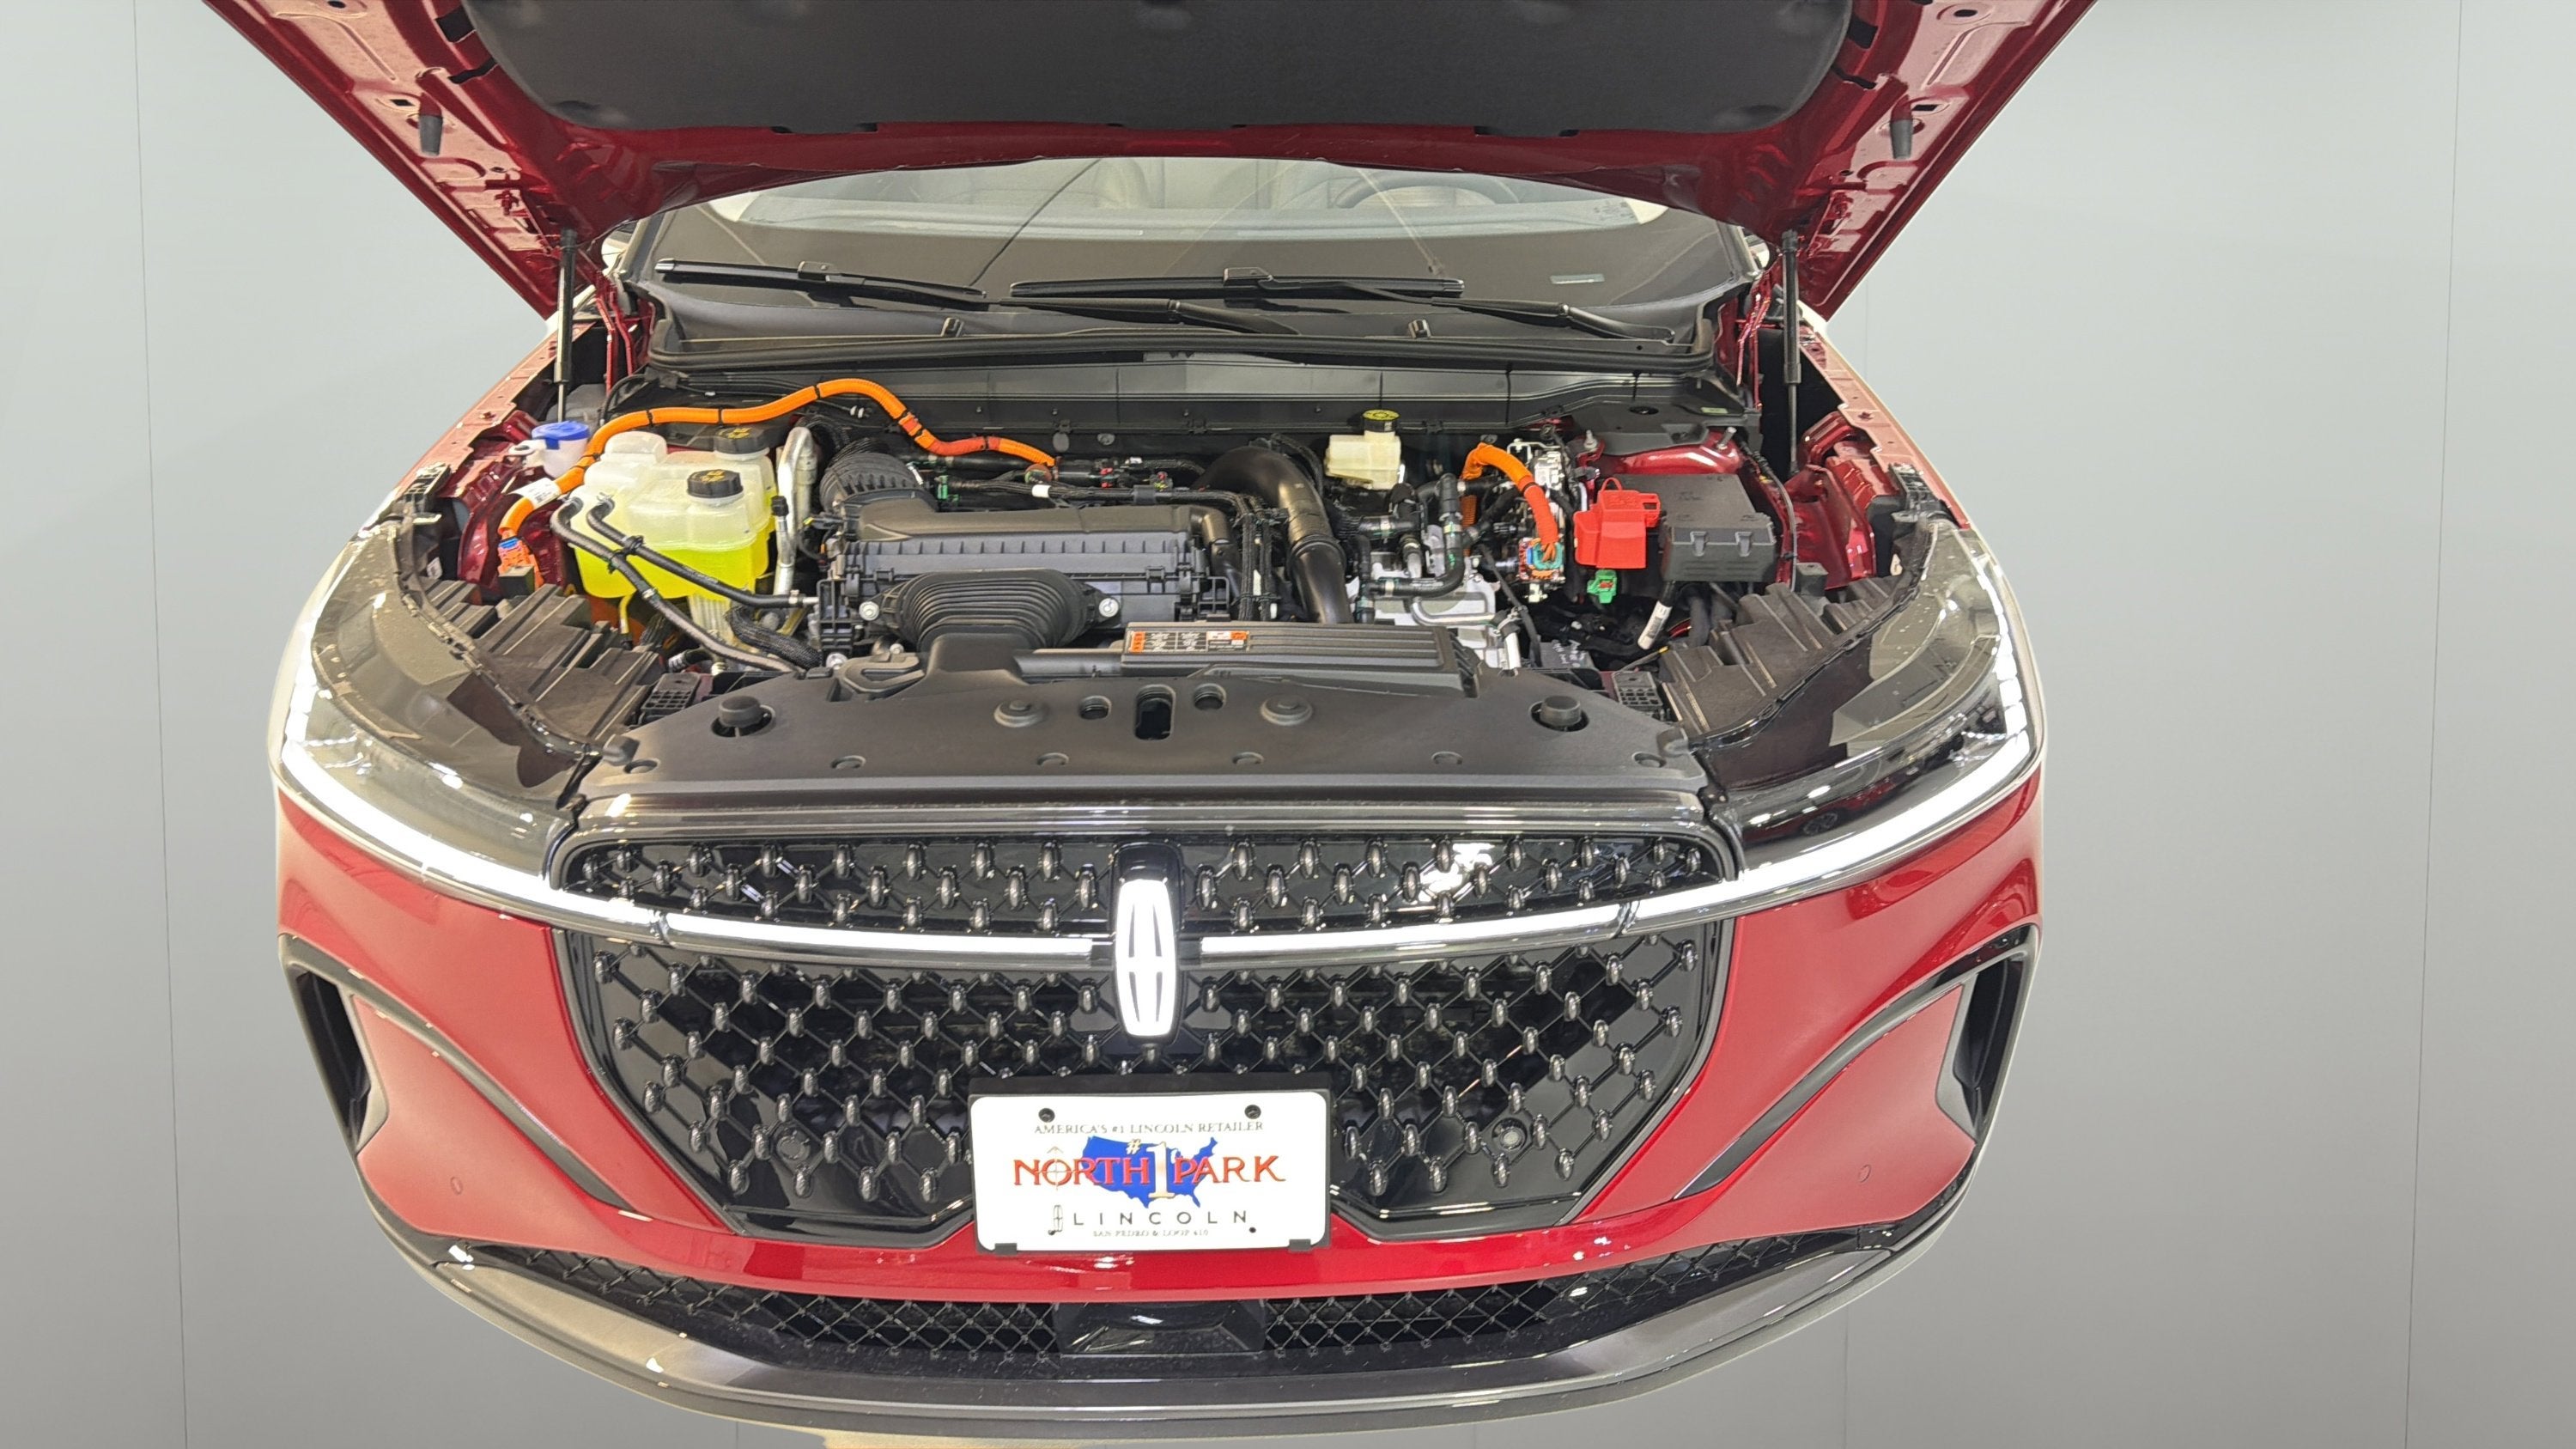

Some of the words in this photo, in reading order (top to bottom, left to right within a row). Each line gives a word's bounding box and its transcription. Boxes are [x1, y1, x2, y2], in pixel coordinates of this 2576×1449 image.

[1034, 1123, 1108, 1135] AMERICA'S
[1130, 1123, 1194, 1133] LINCOLN
[1198, 1121, 1263, 1133] RETAILER
[1013, 1156, 1150, 1186] NORTH
[1173, 1155, 1286, 1184] PARK
[1073, 1210, 1247, 1226] LINCOLN
